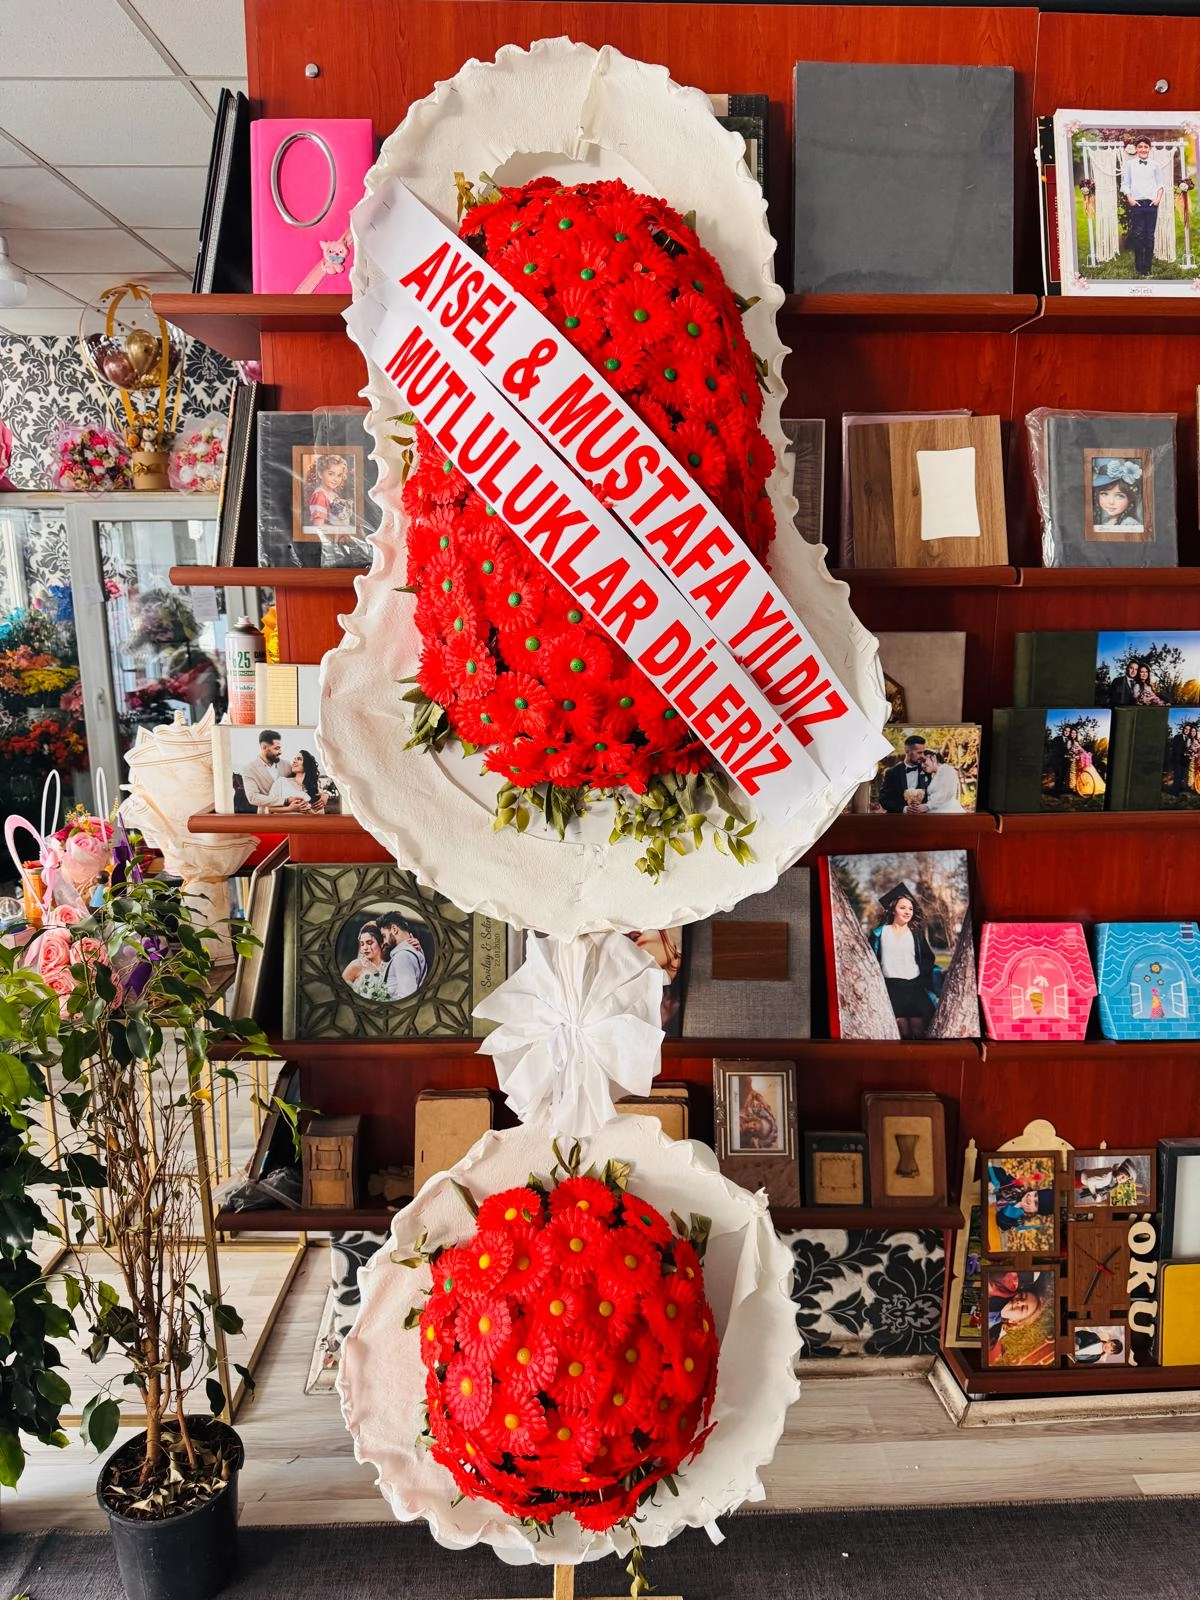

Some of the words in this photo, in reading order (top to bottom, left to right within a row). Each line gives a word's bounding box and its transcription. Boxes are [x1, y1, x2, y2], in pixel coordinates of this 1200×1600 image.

[384, 325, 660, 645] MUTLULUKLAR
[637, 619, 793, 797] DİLERİZ
[400, 241, 517, 367] AYSEL
[501, 337, 559, 402] &
[537, 373, 751, 621] MUSTAFA
[727, 590, 850, 748] YILDIZ
[1126, 1213, 1158, 1367] OKU
